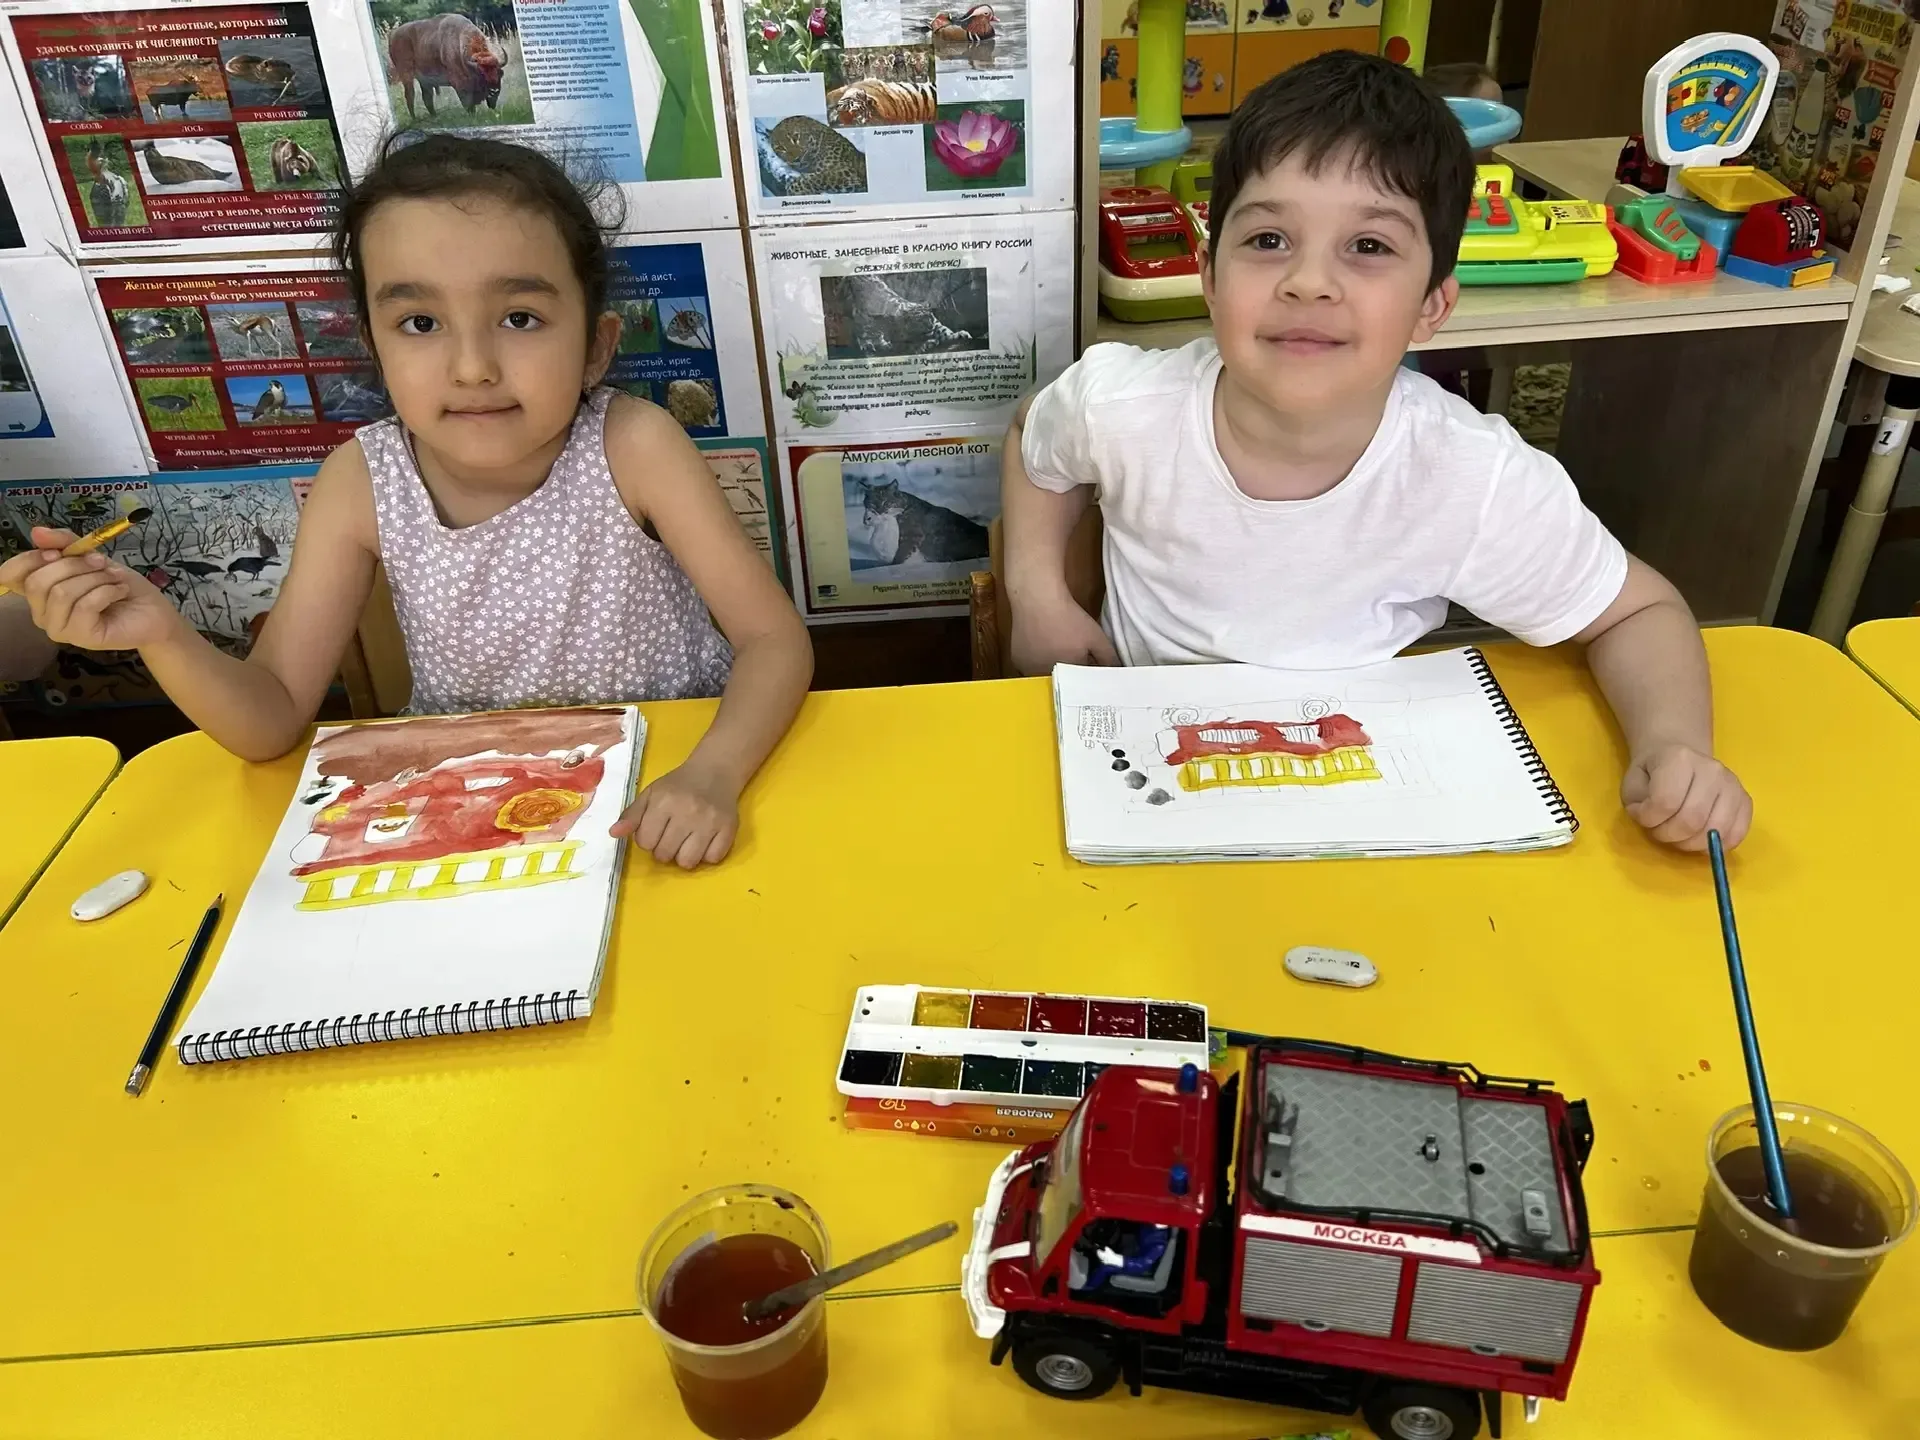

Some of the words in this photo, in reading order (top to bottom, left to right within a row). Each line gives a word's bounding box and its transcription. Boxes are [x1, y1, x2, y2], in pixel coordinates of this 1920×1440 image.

[147, 24, 158, 32] те
[160, 22, 218, 32] животные,
[220, 20, 264, 30] которых
[267, 18, 288, 26] нам
[36, 45, 77, 57] удалось
[80, 42, 133, 54] сохранить
[136, 39, 148, 49] их
[254, 111, 287, 119] РЕЧНОЙ
[288, 110, 308, 118] БОБР
[70, 122, 103, 130] СОБОЛЬ
[148, 196, 216, 206] ОБЫКНОВЕННЫЙ
[152, 210, 170, 220] Их
[170, 210, 215, 221] разводят
[226, 208, 263, 218] неволе,
[264, 204, 297, 214] чтобы
[300, 204, 340, 214] вернуть
[202, 222, 272, 232] естественные
[273, 220, 302, 229] места
[770, 249, 831, 261] ЖИВОТНЫЕ,
[834, 246, 900, 257] ЗАНЕСЕННЫЕ
[903, 246, 909, 254] В
[912, 242, 959, 253] КРАСНУЮ
[962, 241, 992, 250] КНИГУ
[995, 238, 1033, 249] РОССИИ
[854, 262, 901, 274] СНЕЖНЫЙ
[902, 260, 925, 270] БАРС
[927, 258, 961, 270] (ИРБИС)
[124, 281, 164, 291] Желтые
[166, 280, 216, 291] страницы
[243, 277, 293, 286] животные
[166, 294, 209, 304] которых
[210, 292, 247, 302] быстро
[249, 290, 318, 300] уменьшается.
[648, 287, 663, 297] др.
[669, 357, 692, 367] ирис
[920, 358, 951, 366] Красную
[953, 356, 974, 364] книгу
[225, 364, 266, 372] АНТИЛОПА
[642, 369, 678, 380] капуста
[689, 369, 704, 379] др.
[848, 372, 882, 380] снежного
[883, 371, 904, 379] барса
[918, 369, 942, 377] горные
[944, 366, 970, 375] районы
[972, 363, 1021, 372] Центральной
[876, 380, 921, 390] проживания
[929, 374, 992, 385] труднодоступной
[848, 392, 884, 400] животное
[816, 403, 870, 413] существующих
[881, 400, 903, 408] нашей
[1879, 431, 1893, 446] 1
[175, 448, 228, 457] Животные,
[230, 447, 283, 456] количество
[285, 445, 325, 454] которых
[841, 447, 910, 464] Амурский
[913, 443, 964, 458] лесной
[968, 443, 990, 454] кот
[6, 483, 64, 497] живой
[70, 480, 149, 496] природы
[997, 1108, 1054, 1119] медовая
[1314, 1225, 1407, 1248] МОСКВА
